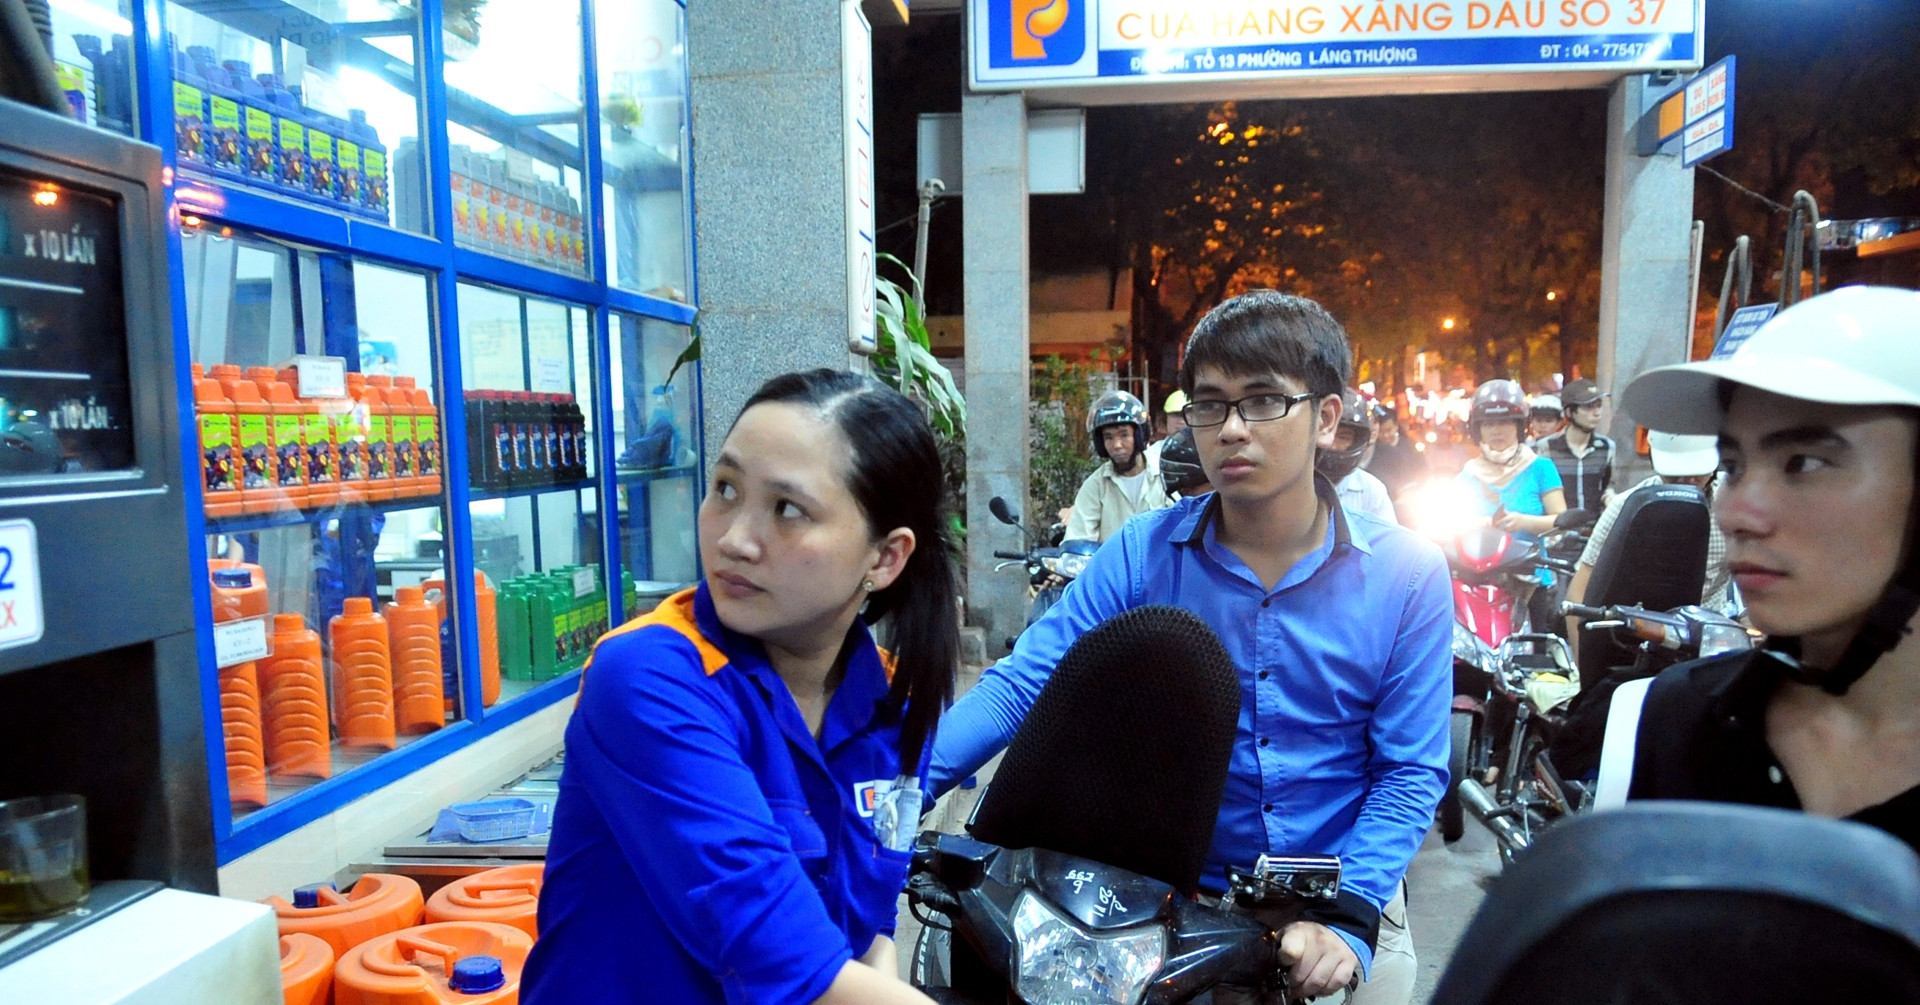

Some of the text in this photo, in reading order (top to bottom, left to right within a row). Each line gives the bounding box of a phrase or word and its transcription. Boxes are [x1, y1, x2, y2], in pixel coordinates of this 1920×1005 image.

[1627, 0, 1665, 26] 37
[1218, 54, 1235, 68] 13
[1237, 49, 1302, 67] PHƯỜNG
[1309, 48, 1350, 65] LÁNG
[1354, 46, 1417, 64] THƯỢNG
[1540, 44, 1561, 58] ĐT
[1572, 44, 1589, 57] 04
[40, 229, 61, 260] 10
[1656, 490, 1698, 499] HONDA
